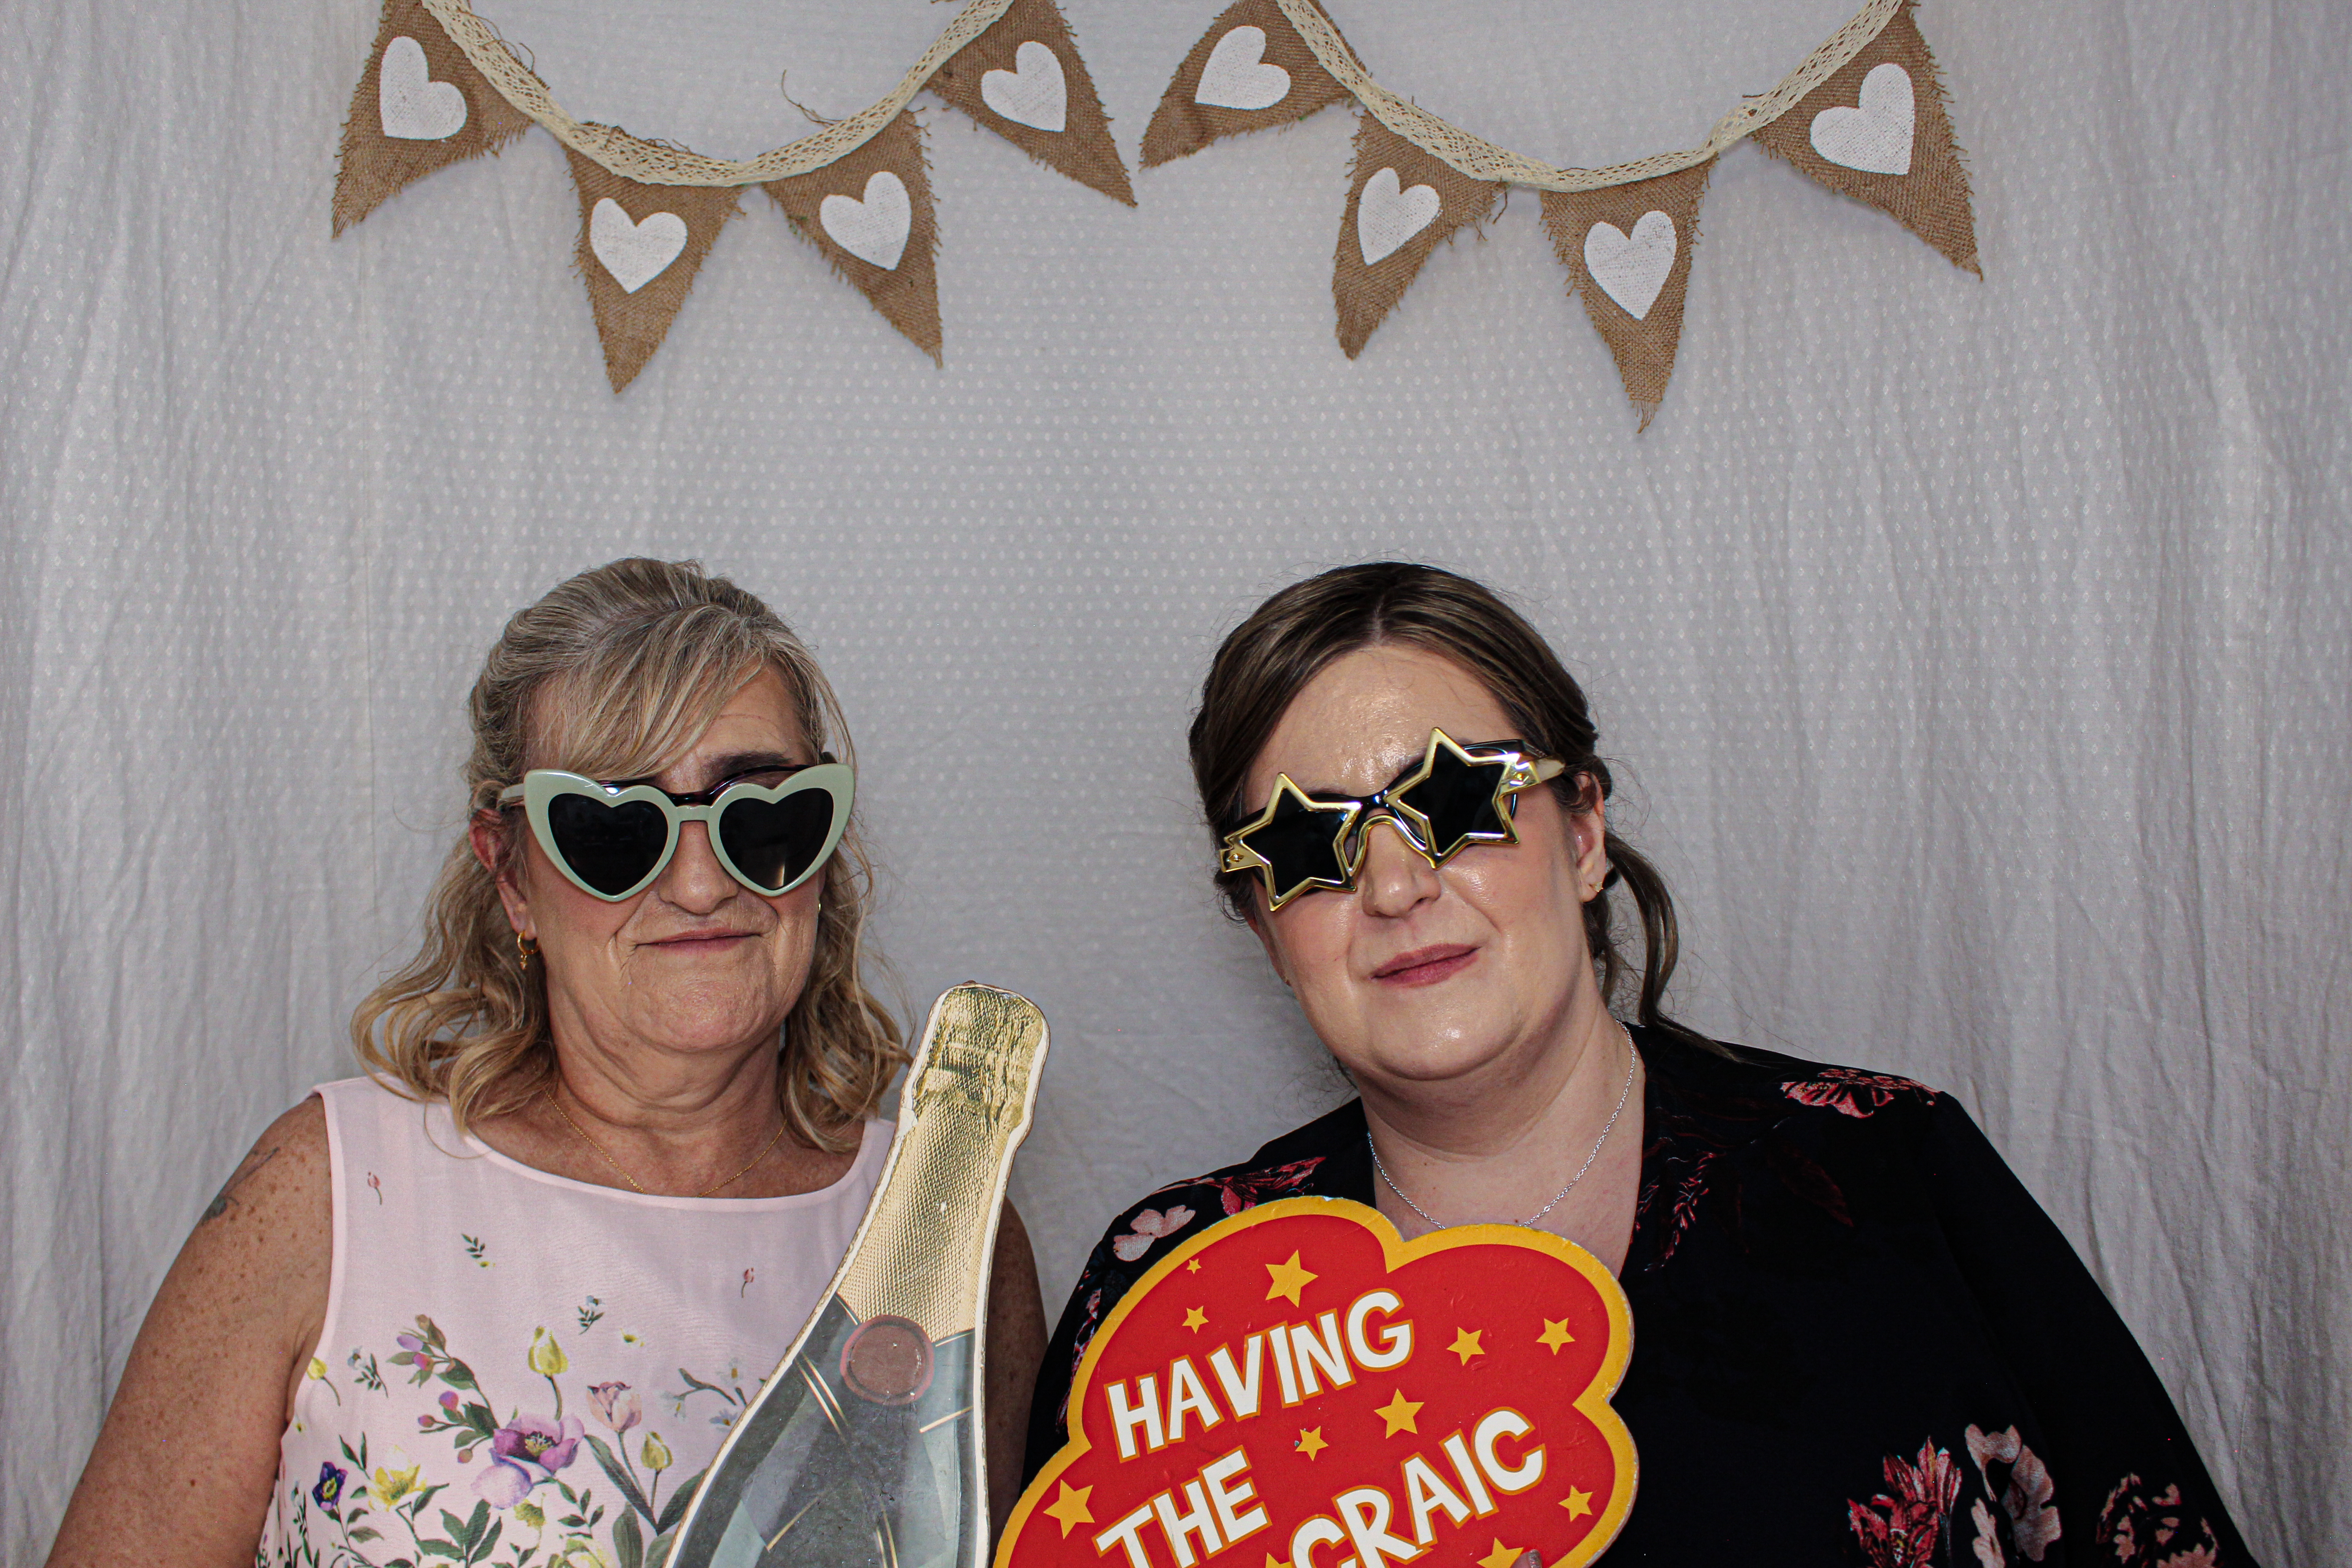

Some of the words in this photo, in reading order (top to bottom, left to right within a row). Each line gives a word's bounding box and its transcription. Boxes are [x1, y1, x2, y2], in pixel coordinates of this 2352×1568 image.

[1107, 1291, 1411, 1458] HAVING
[1095, 1450, 1268, 1568] THE
[1292, 1410, 1543, 1568] CRAIC
